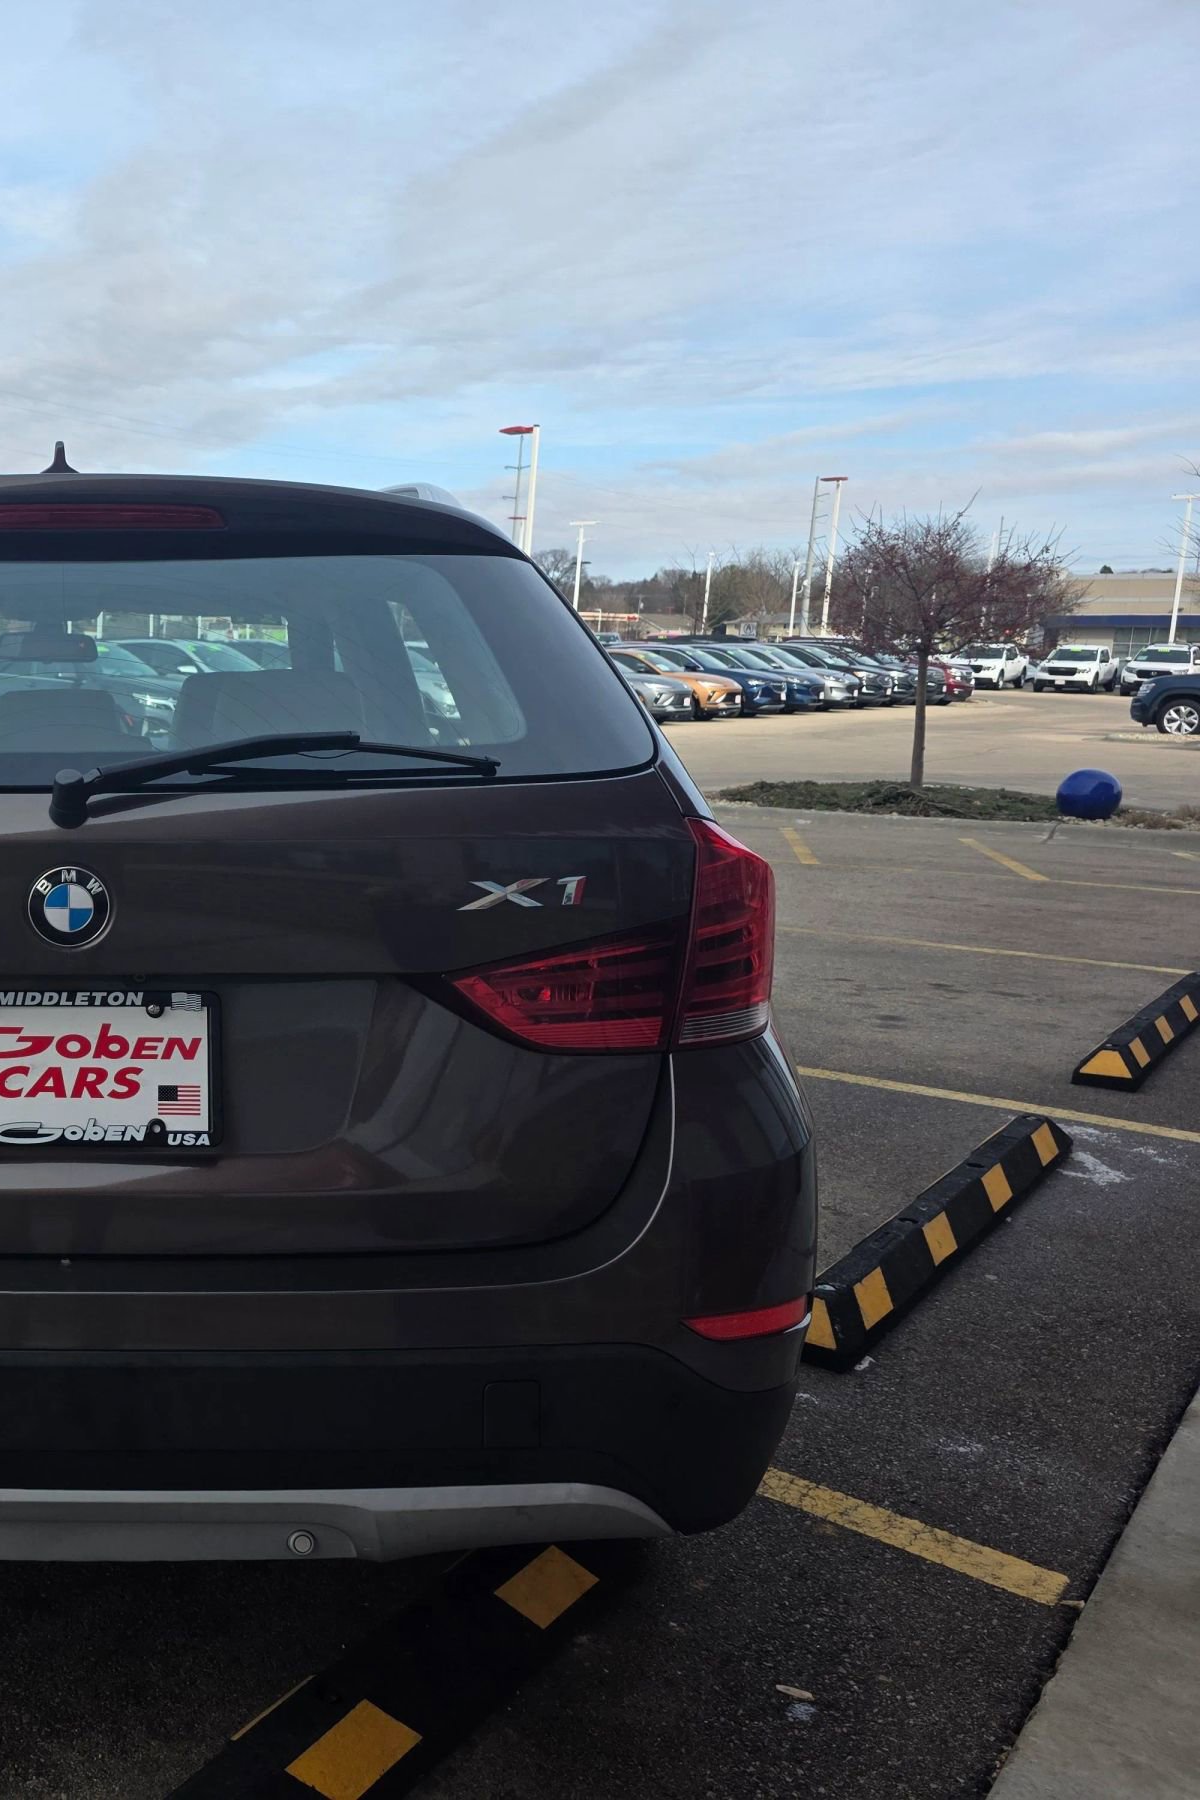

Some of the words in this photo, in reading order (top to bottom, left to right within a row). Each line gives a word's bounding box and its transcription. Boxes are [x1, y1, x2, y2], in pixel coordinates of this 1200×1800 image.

[36, 869, 103, 895] BMW
[456, 875, 589, 911] X1
[167, 1133, 211, 1146] USA
